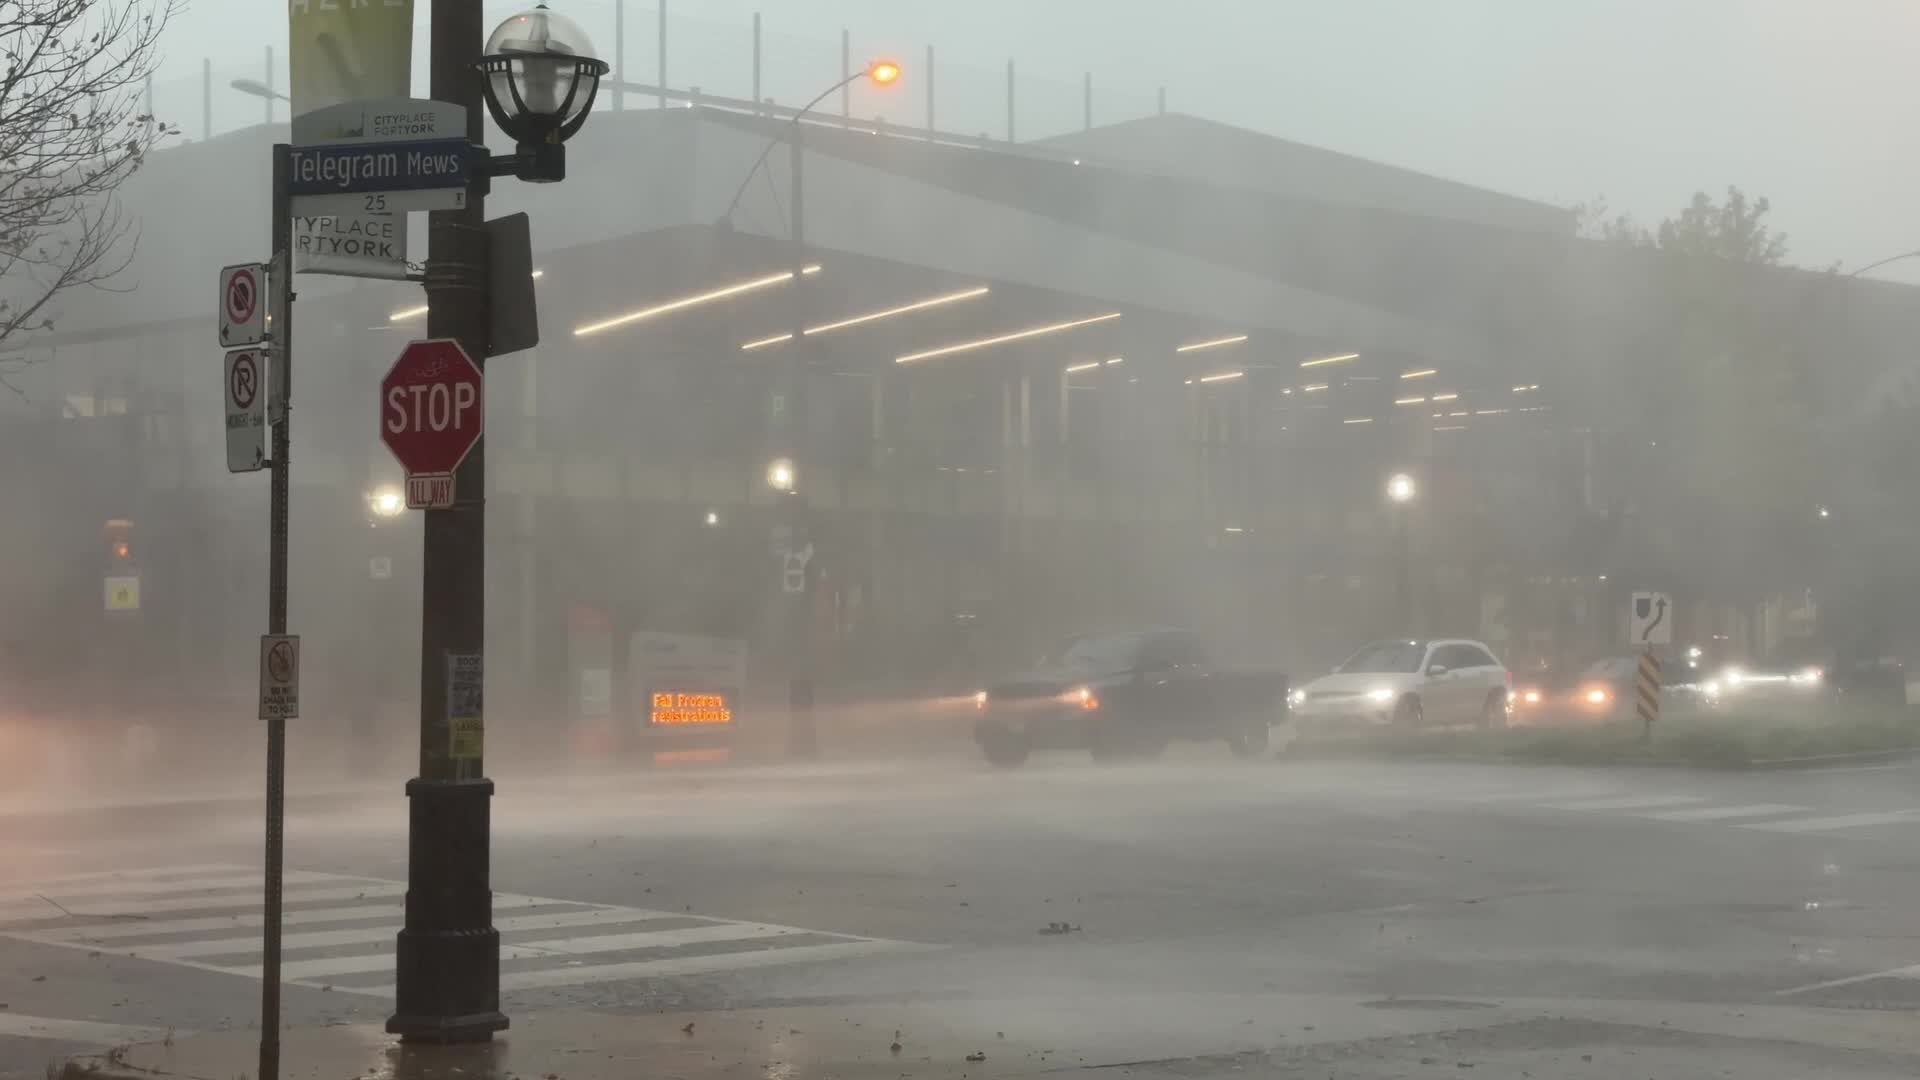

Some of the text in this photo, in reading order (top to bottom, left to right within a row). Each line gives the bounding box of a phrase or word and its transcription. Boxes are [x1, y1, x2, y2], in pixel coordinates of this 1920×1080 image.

[374, 112, 435, 126] CITYPLACE
[374, 120, 434, 137] FORTYORK
[290, 151, 458, 187] Telegram Mews
[364, 195, 386, 211] 25
[387, 382, 475, 434] STOP
[409, 479, 451, 505] ALL WAY
[653, 693, 673, 708] Fall
